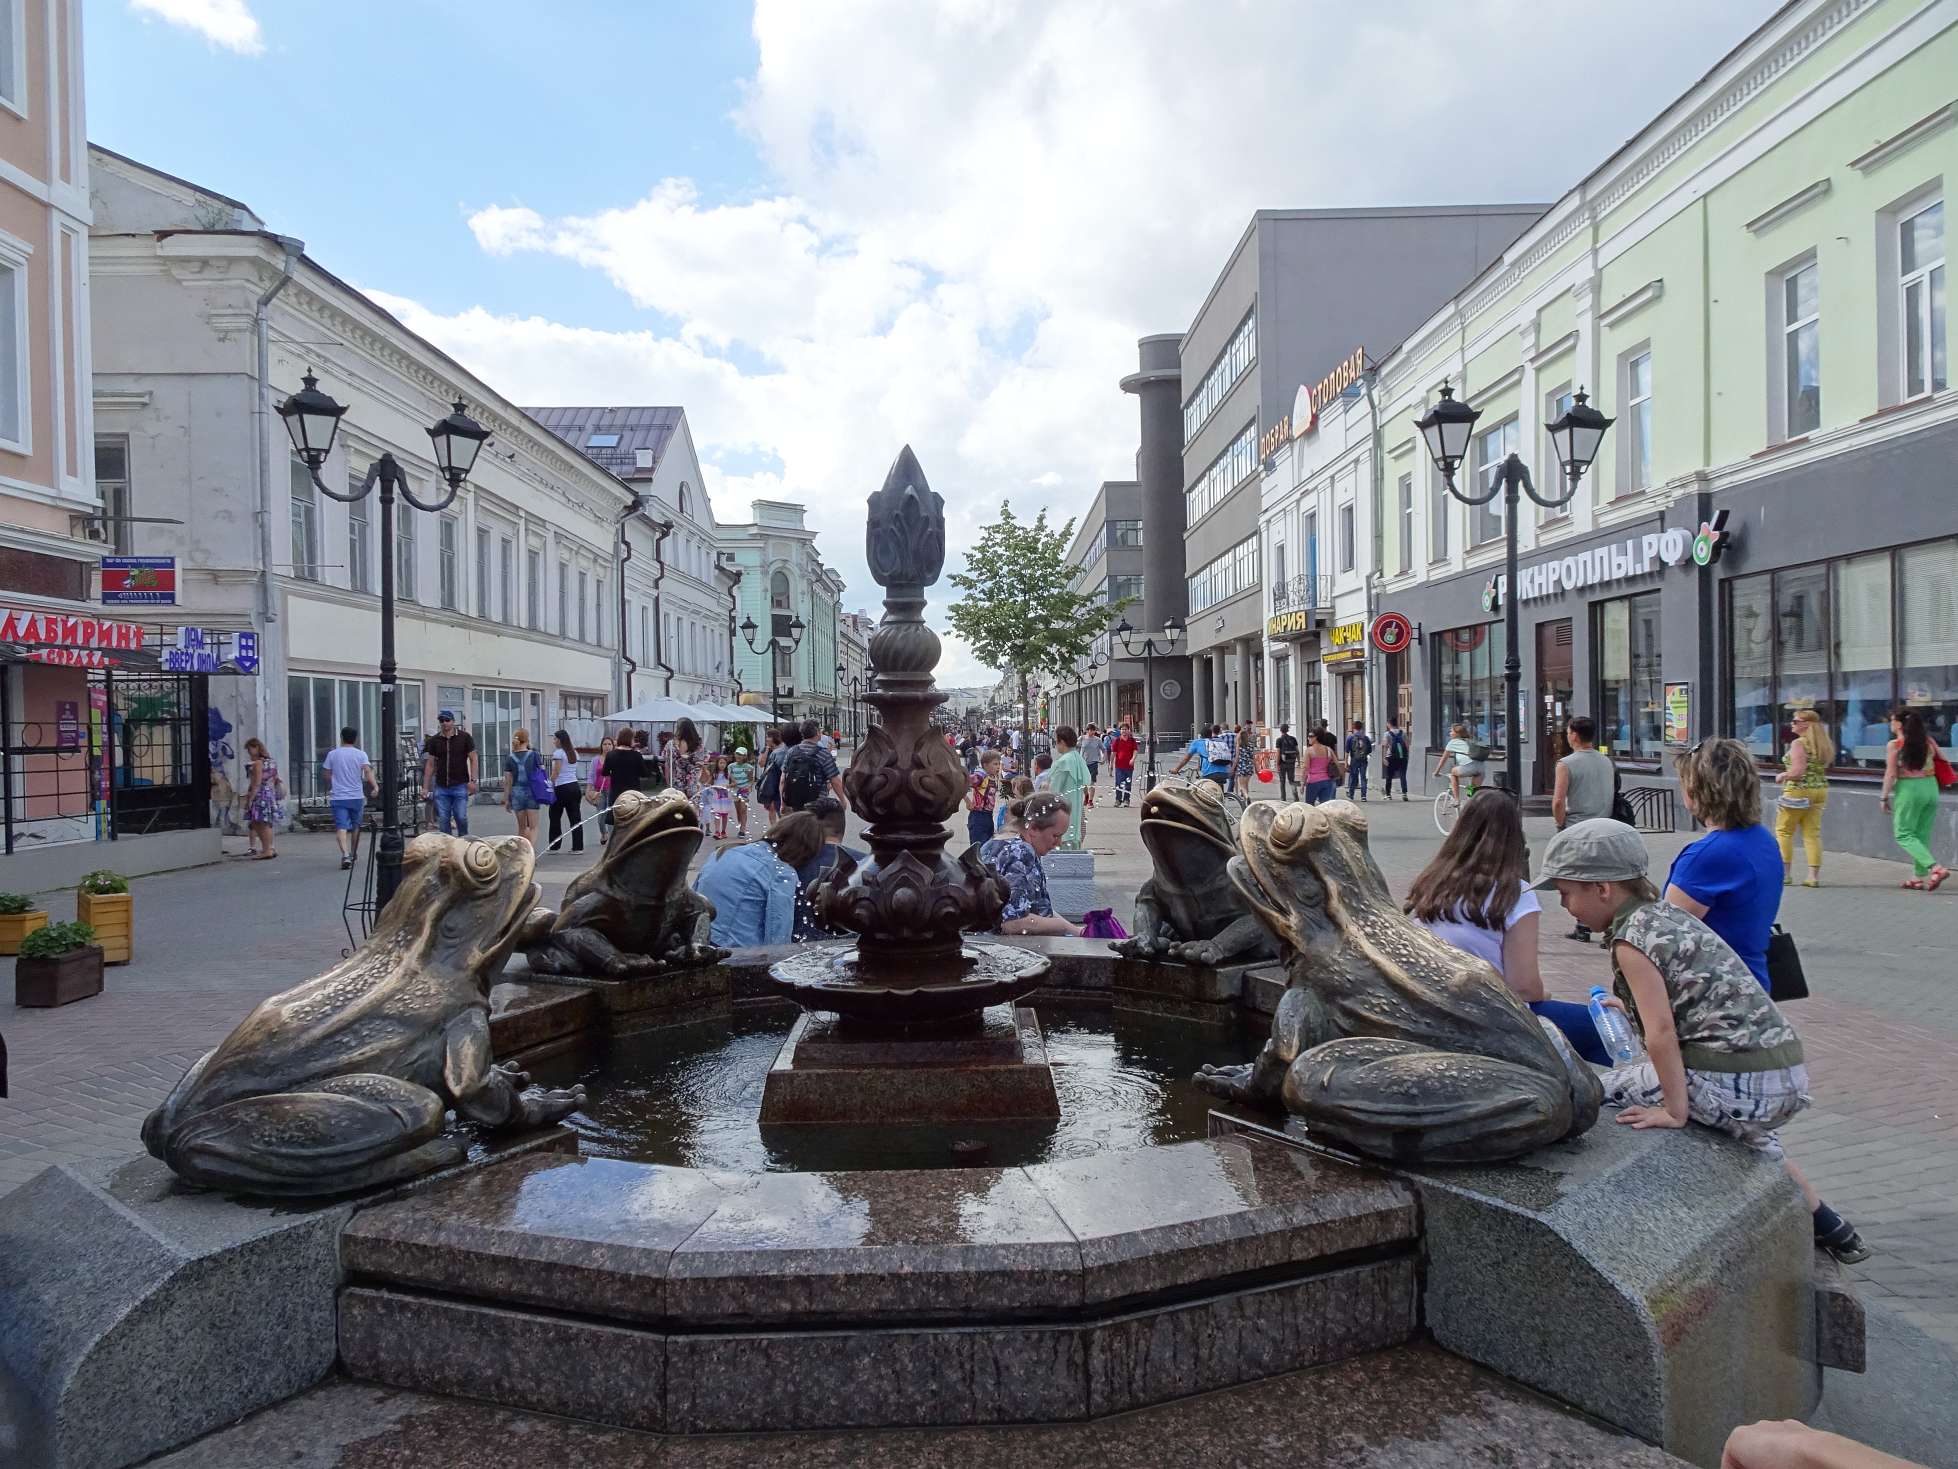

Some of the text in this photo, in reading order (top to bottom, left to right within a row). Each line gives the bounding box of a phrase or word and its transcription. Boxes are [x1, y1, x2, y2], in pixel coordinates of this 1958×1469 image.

[1261, 346, 1364, 464] ДОБРАЯ СТОЛОВАЯ
[1498, 527, 1688, 605] РКНРОЛЛЫ.РФ
[0, 610, 145, 652] ЛАБИРИНТ
[1330, 623, 1362, 646] ЧАК-ЧАК
[47, 648, 105, 669] СТРАХА
